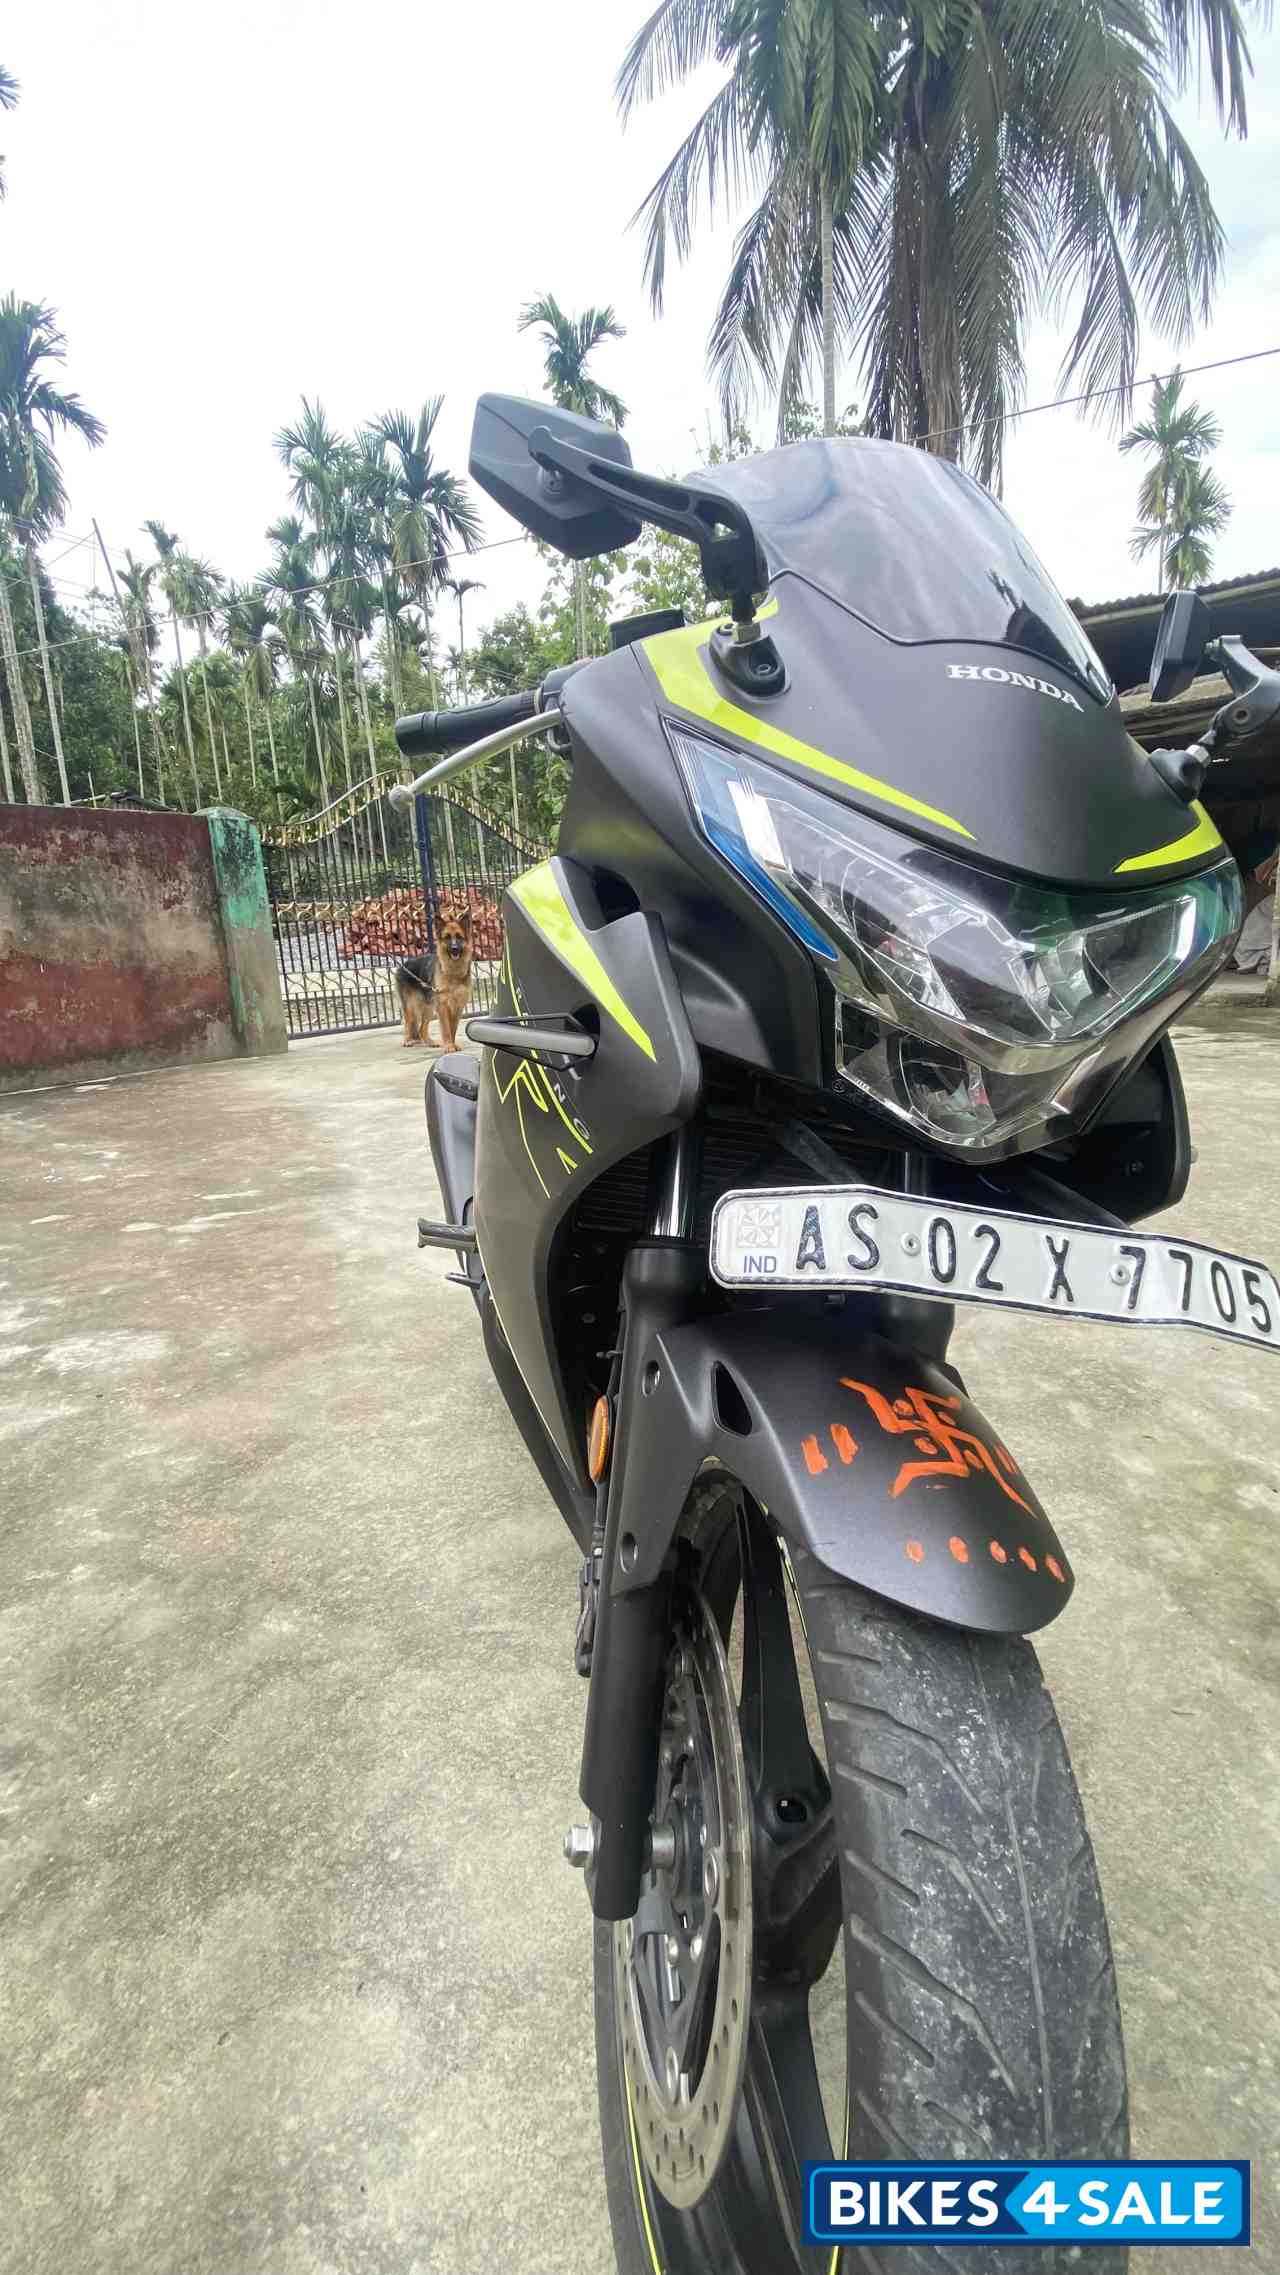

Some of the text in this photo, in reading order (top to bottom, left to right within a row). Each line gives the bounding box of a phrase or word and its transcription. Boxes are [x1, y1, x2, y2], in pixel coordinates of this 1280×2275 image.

[946, 664, 1085, 713] HONDA
[743, 1255, 777, 1273] IND
[796, 1203, 1272, 1333] AS 02 X 7705
